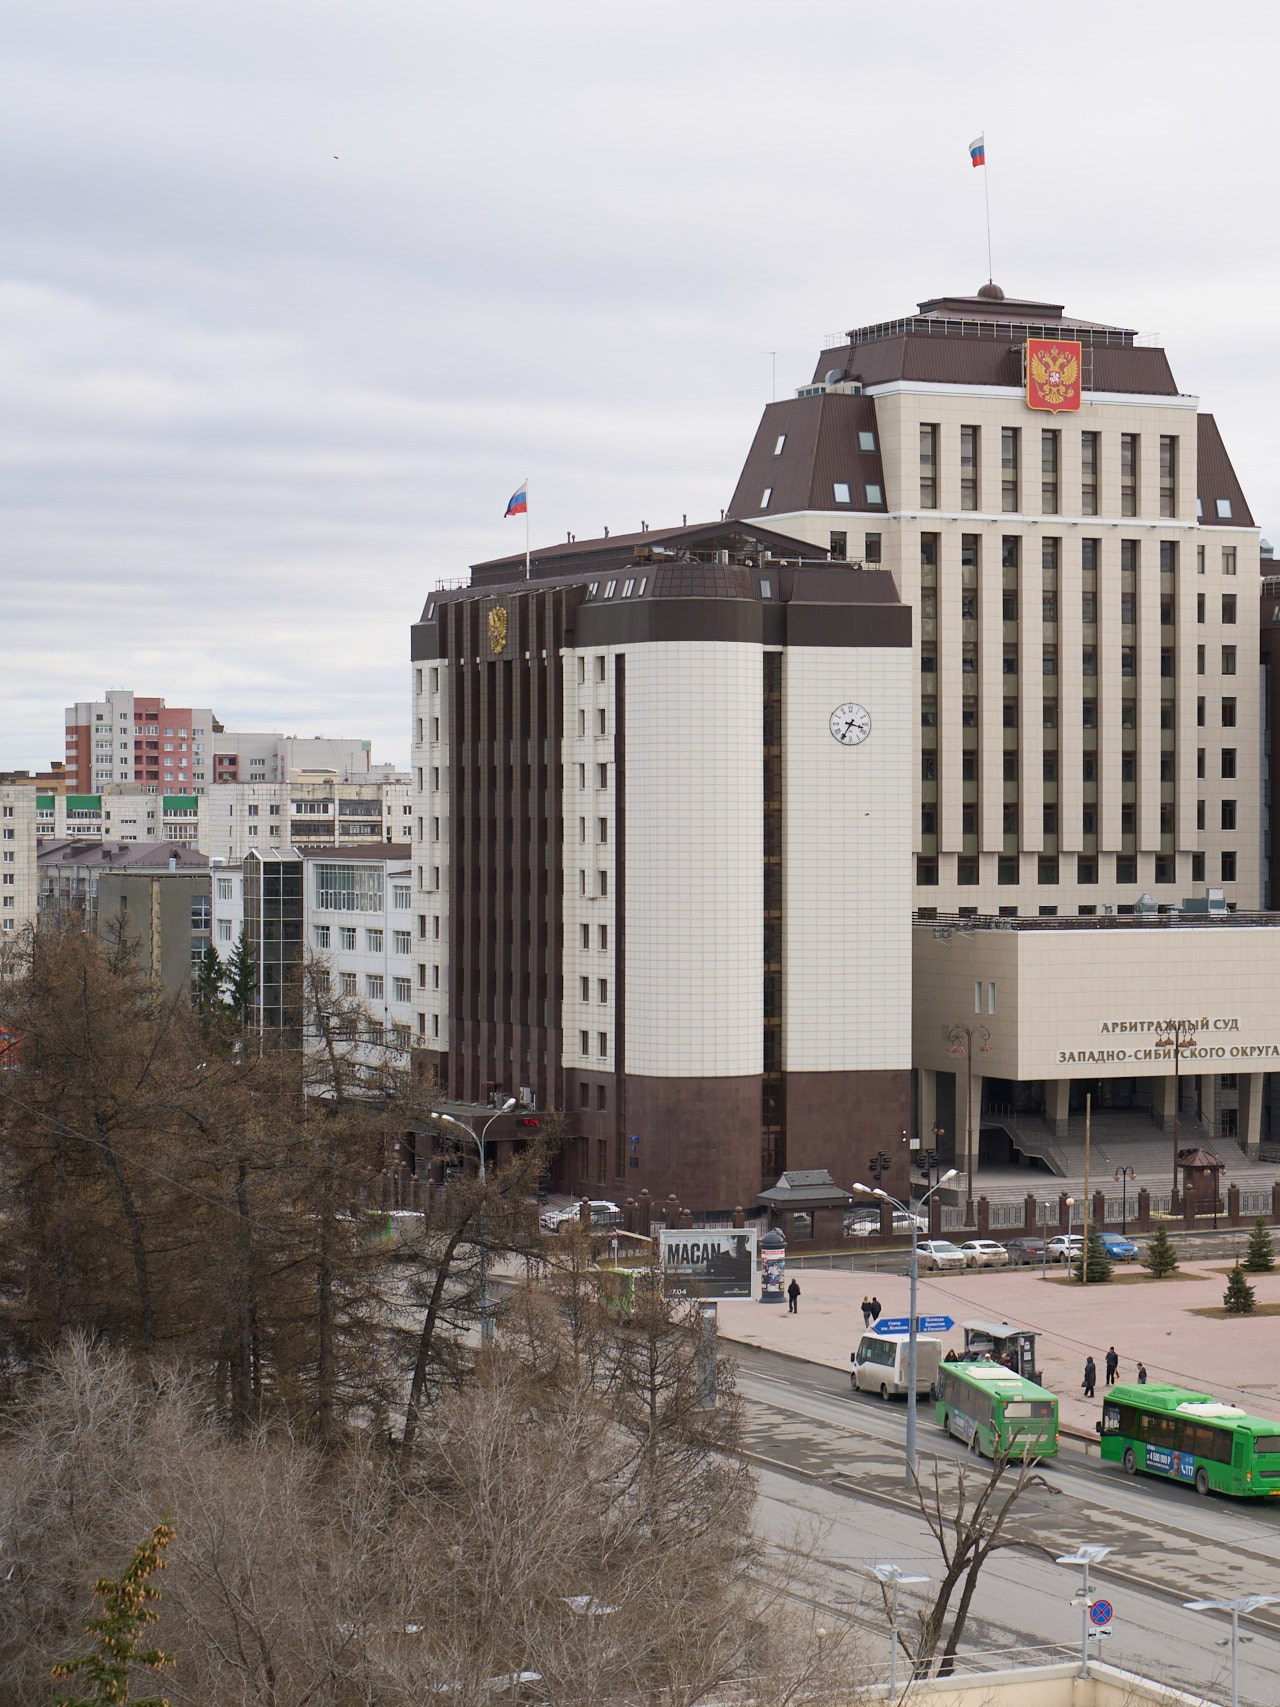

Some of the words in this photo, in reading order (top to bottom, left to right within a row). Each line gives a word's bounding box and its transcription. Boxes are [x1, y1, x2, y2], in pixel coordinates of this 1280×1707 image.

[1100, 1017, 1210, 1033] АРБИТРАЖНЫЙ
[1213, 1018, 1239, 1032] СУД
[1058, 1047, 1226, 1064] ЗАПАДНО-СИБИРСКОГО
[1230, 1045, 1280, 1058] ОКРУГА
[667, 1243, 721, 1265] MACAN
